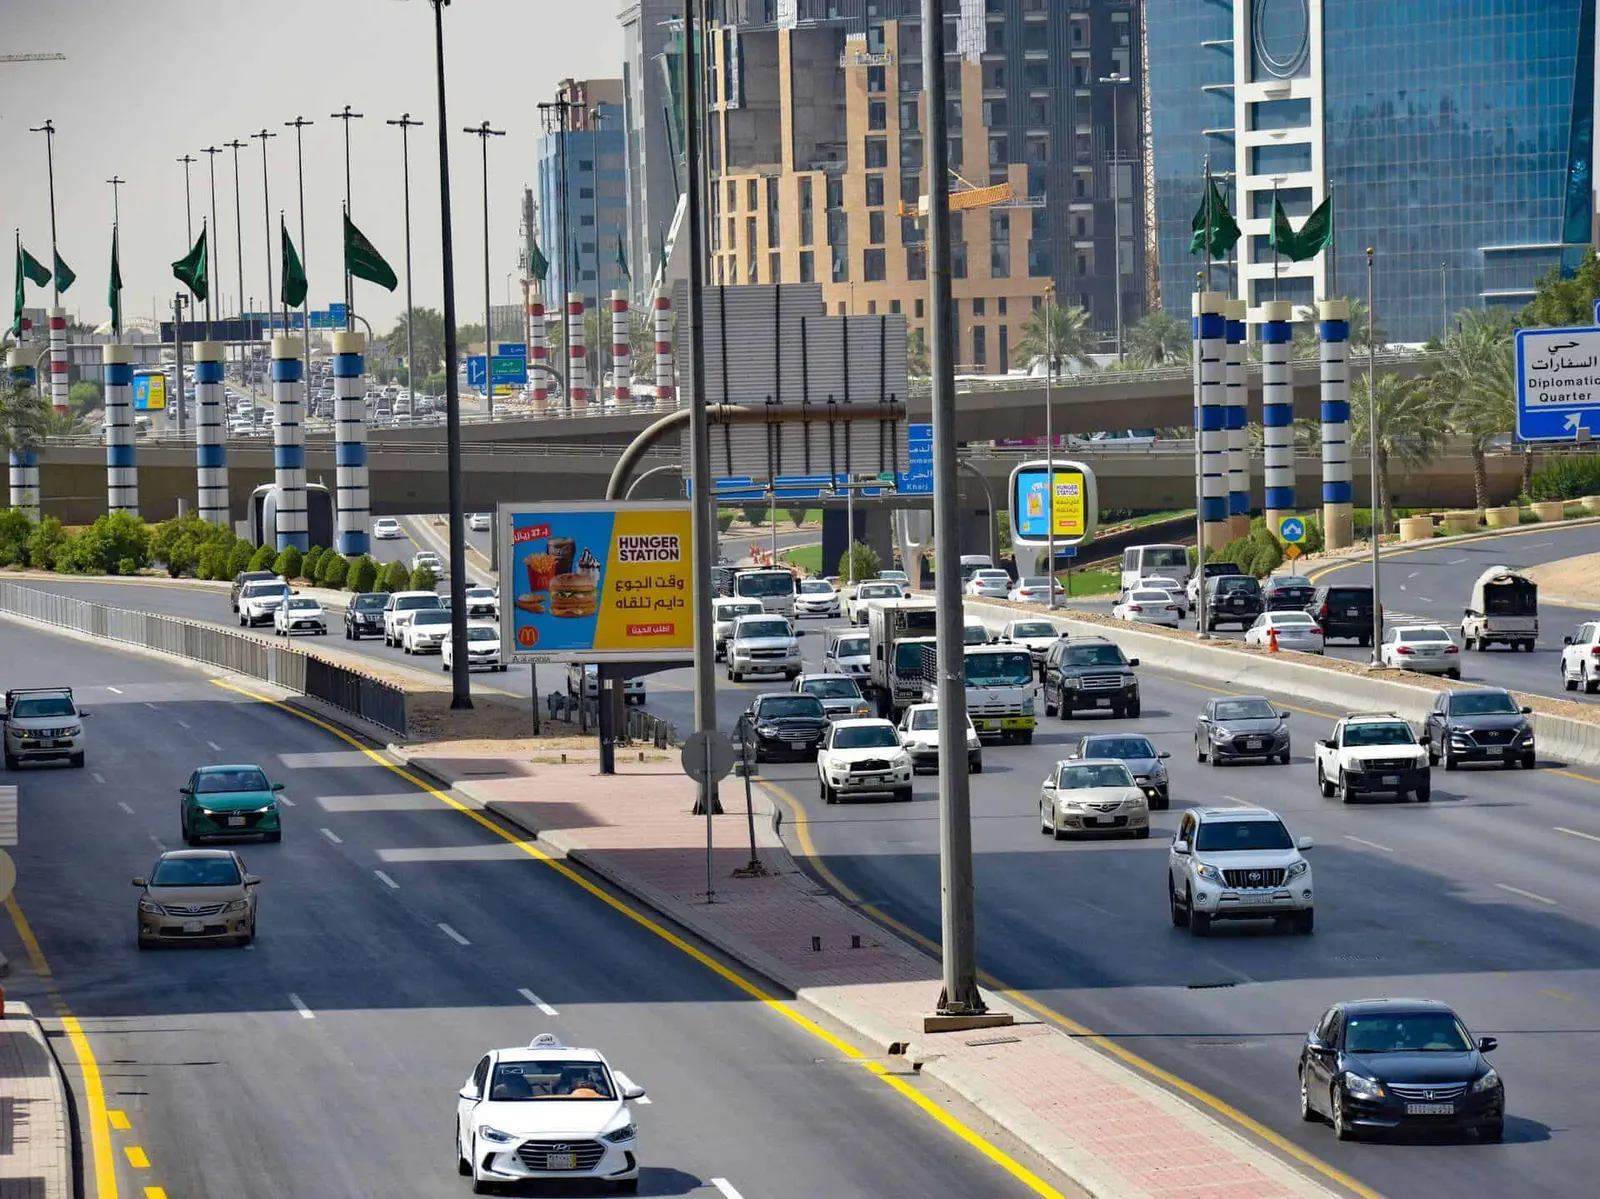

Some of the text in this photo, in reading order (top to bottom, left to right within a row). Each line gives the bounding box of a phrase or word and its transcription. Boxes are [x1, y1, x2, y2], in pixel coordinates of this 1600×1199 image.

[1547, 340, 1580, 355] حي
[1531, 356, 1598, 372] السفارات
[1539, 391, 1592, 403] Quarter
[619, 536, 679, 549] HUNGER
[619, 549, 679, 561] STATION
[615, 575, 684, 592] وقت الجوع
[615, 596, 684, 611] دايم تلقاه
